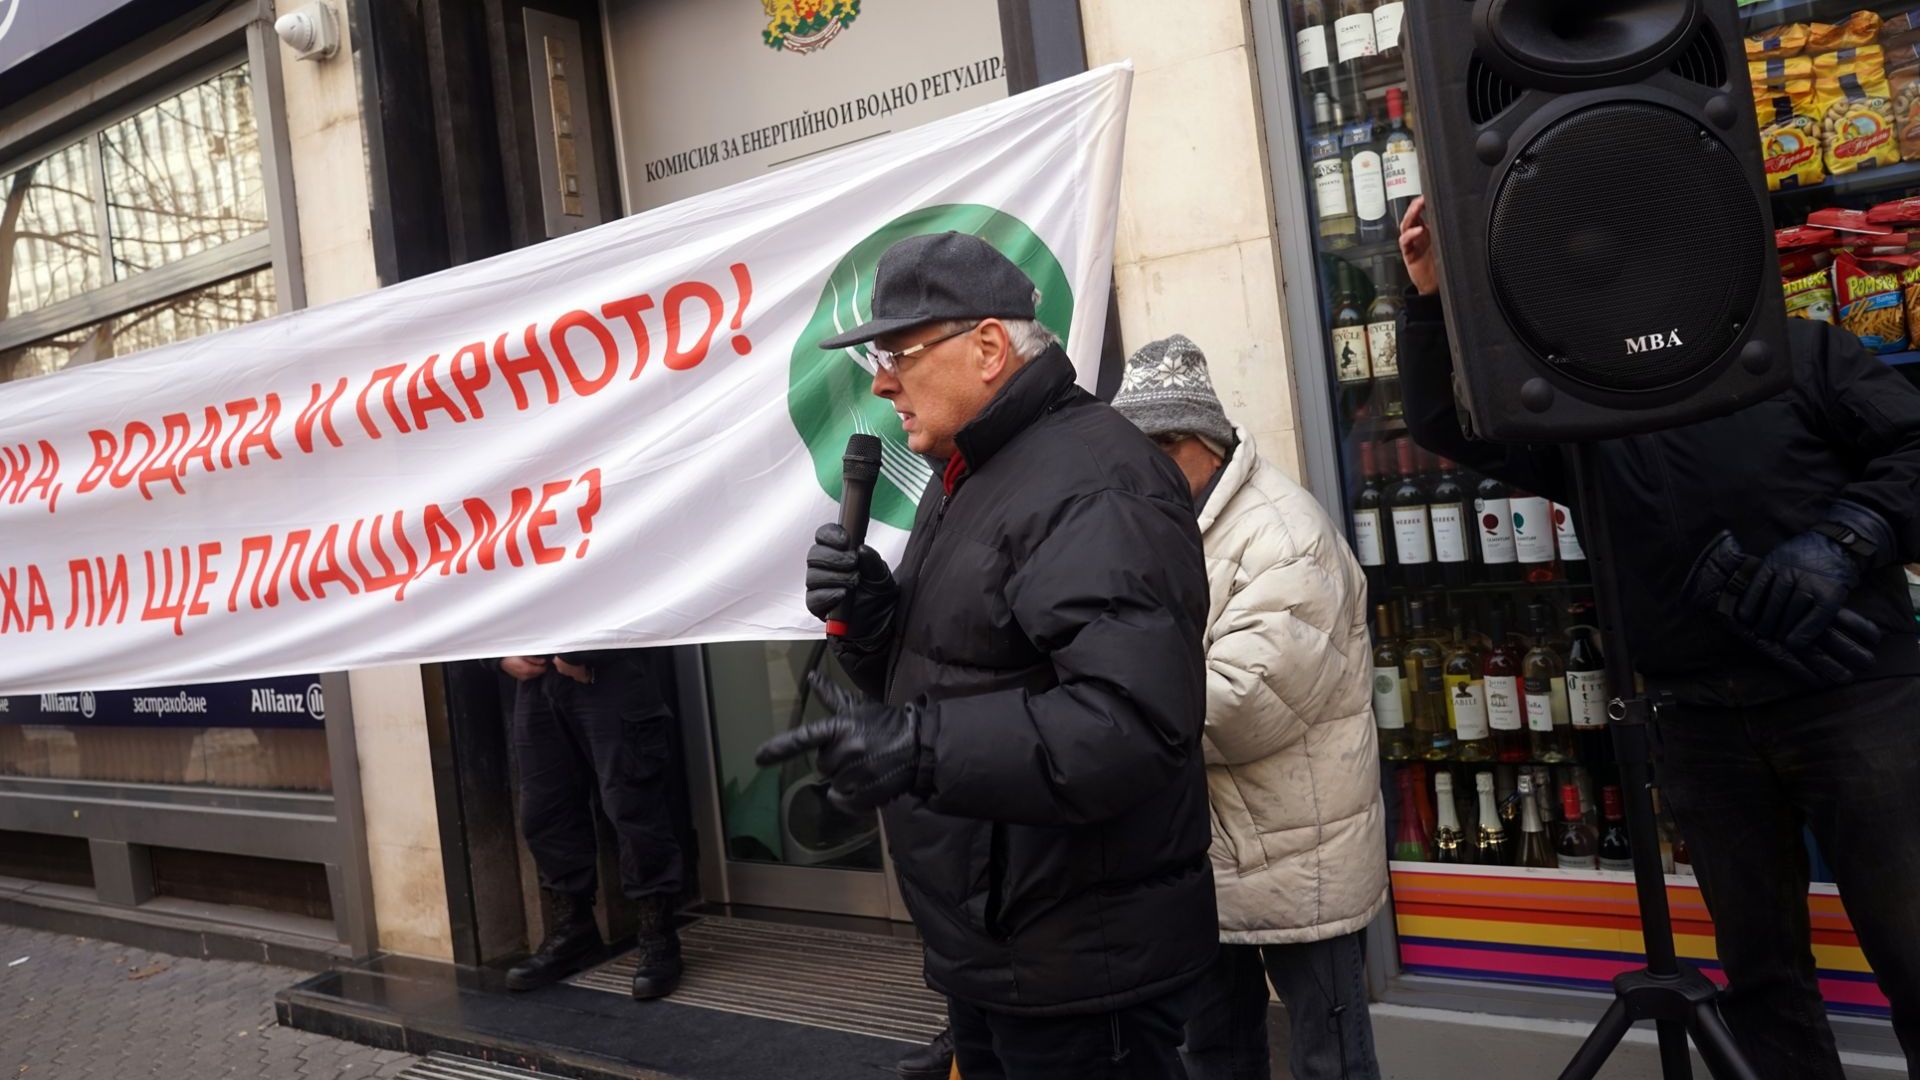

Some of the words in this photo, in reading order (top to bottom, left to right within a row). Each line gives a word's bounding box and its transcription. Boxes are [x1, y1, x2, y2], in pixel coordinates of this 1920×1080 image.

[645, 142, 720, 183] КОМИСИЯ
[722, 138, 740, 162] ЗА
[742, 106, 839, 154] ЕНЕРГИЙНО
[841, 102, 854, 125] И
[856, 82, 918, 120] ВОДНО
[1624, 330, 1683, 355] MBA
[76, 392, 282, 500] ВОДАТА
[295, 377, 348, 453] И
[356, 263, 753, 440] ПАРНОТО!
[65, 554, 129, 629] ЛИ
[141, 542, 222, 636] ЩЕ
[228, 468, 601, 612] ПЛАЩАМЕ?
[40, 692, 79, 712] Allianz
[132, 691, 207, 717] застраховане
[251, 688, 305, 713] Allianz
